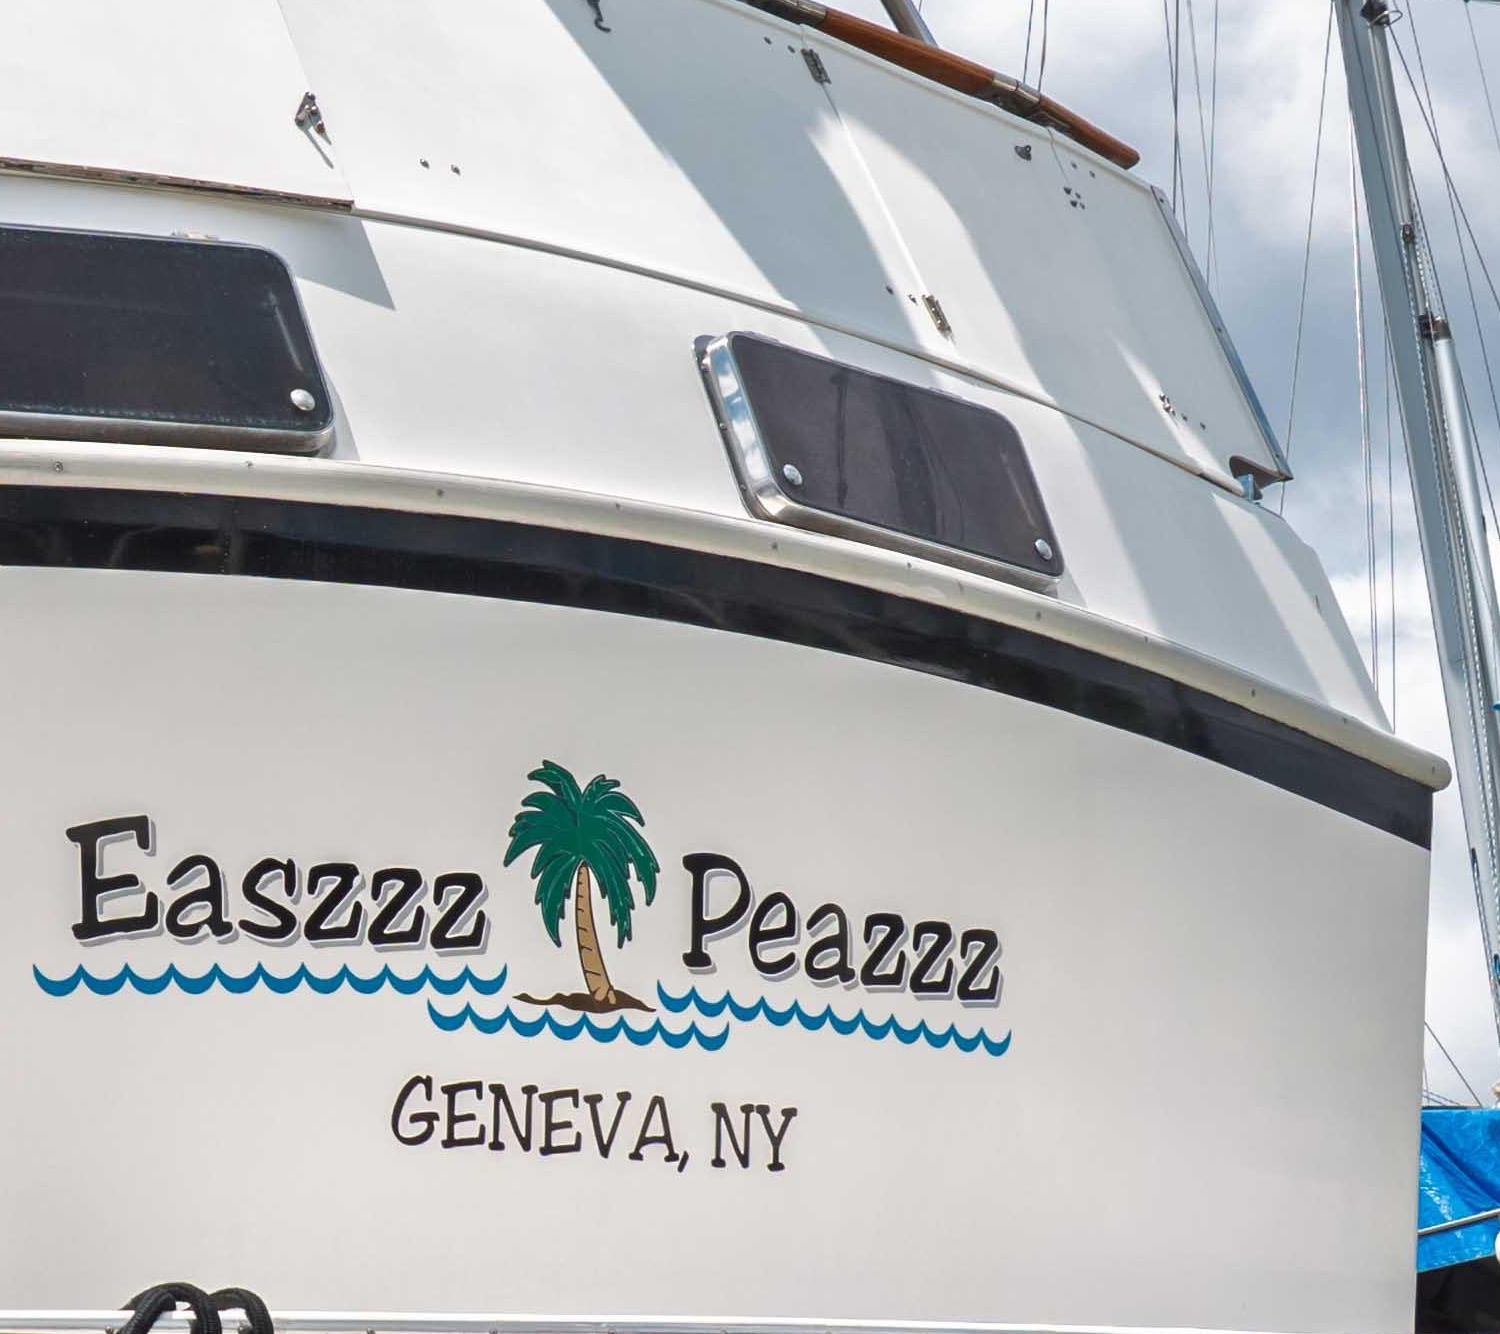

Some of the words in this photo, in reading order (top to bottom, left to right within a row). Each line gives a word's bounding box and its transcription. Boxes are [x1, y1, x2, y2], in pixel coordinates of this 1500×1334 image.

[65, 814, 489, 956] Easzzz
[682, 852, 1002, 1008] Peazzz
[391, 1075, 689, 1173] GENEVA,
[711, 1102, 798, 1172] NY
